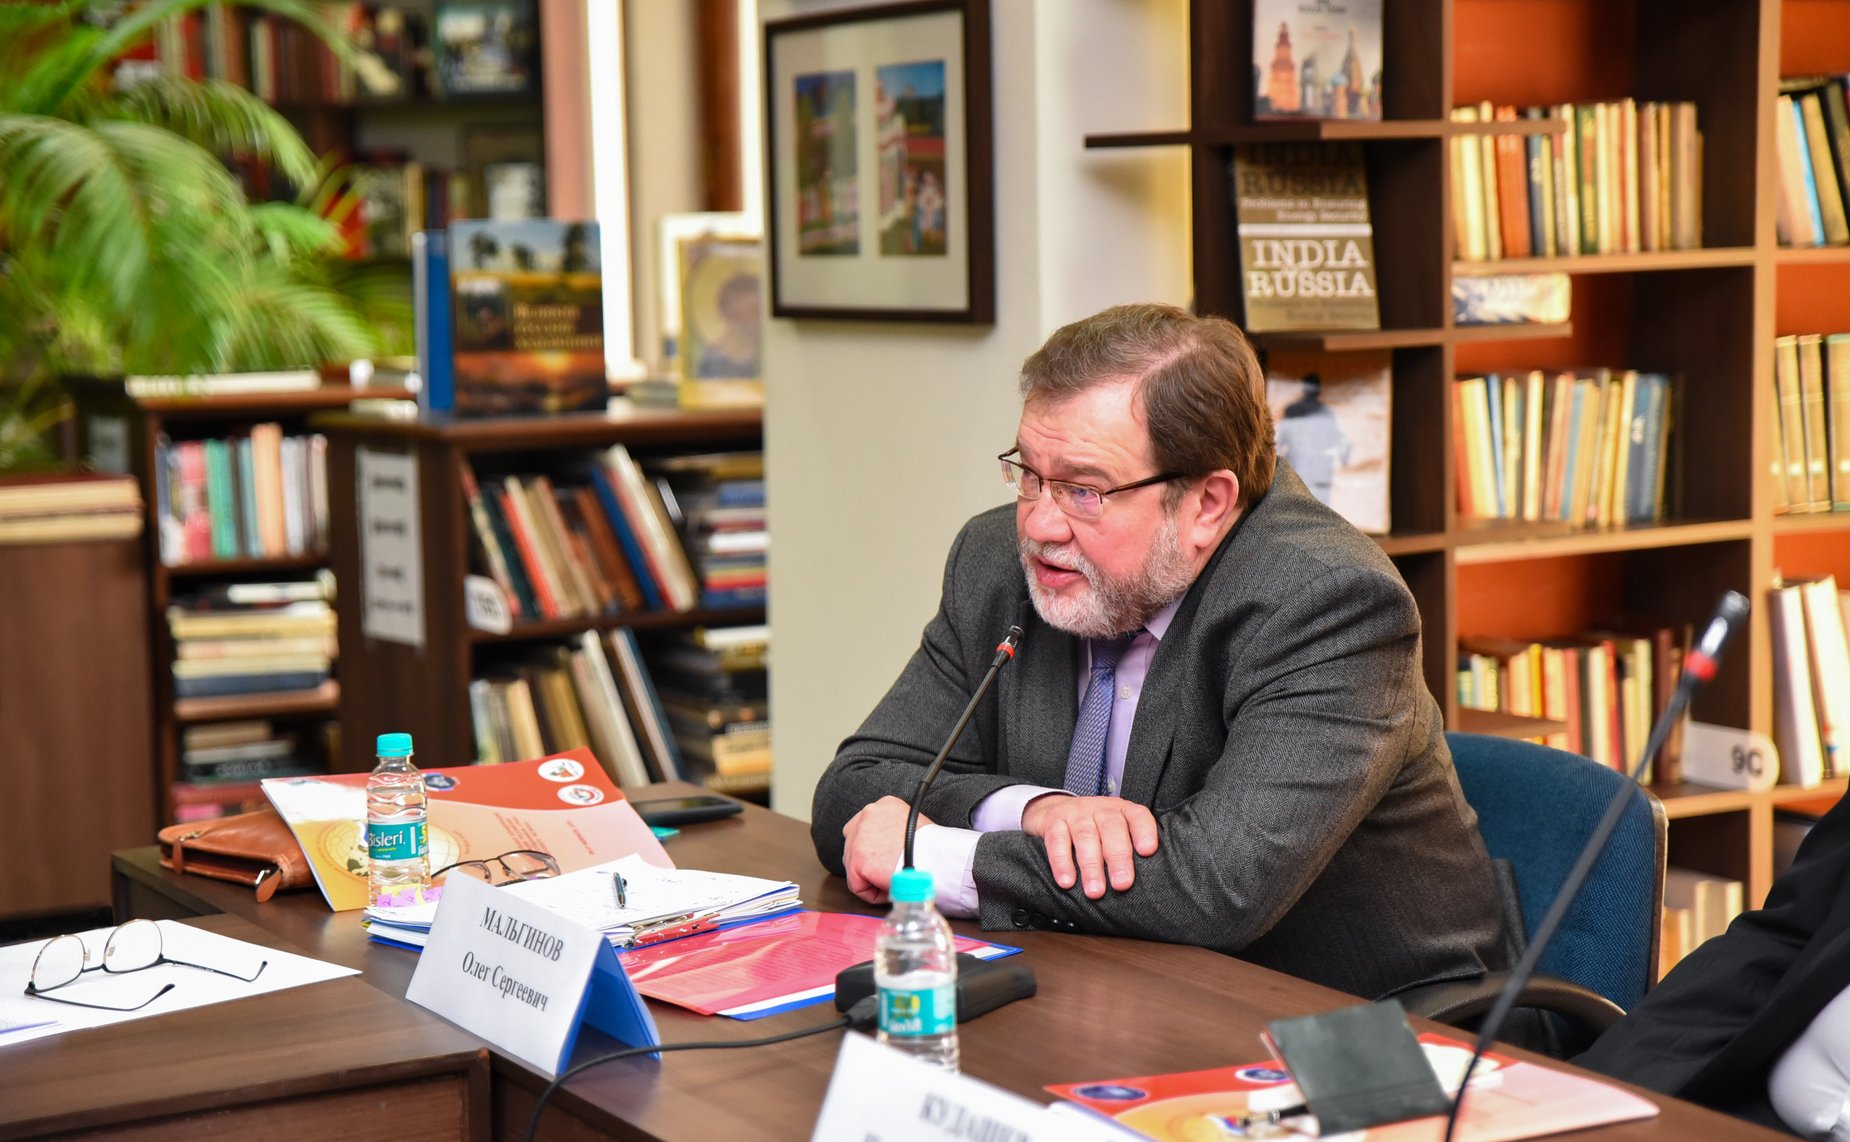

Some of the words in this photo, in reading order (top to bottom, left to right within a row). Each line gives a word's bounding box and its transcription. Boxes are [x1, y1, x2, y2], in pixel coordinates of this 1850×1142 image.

[1252, 239, 1369, 268] INDIA
[1247, 270, 1376, 297] RUSSIA
[1730, 744, 1763, 777] 9C
[479, 906, 565, 962] МАЛЬГИНОВ
[462, 951, 491, 982] Олег
[491, 965, 549, 1012] Сергеевич
